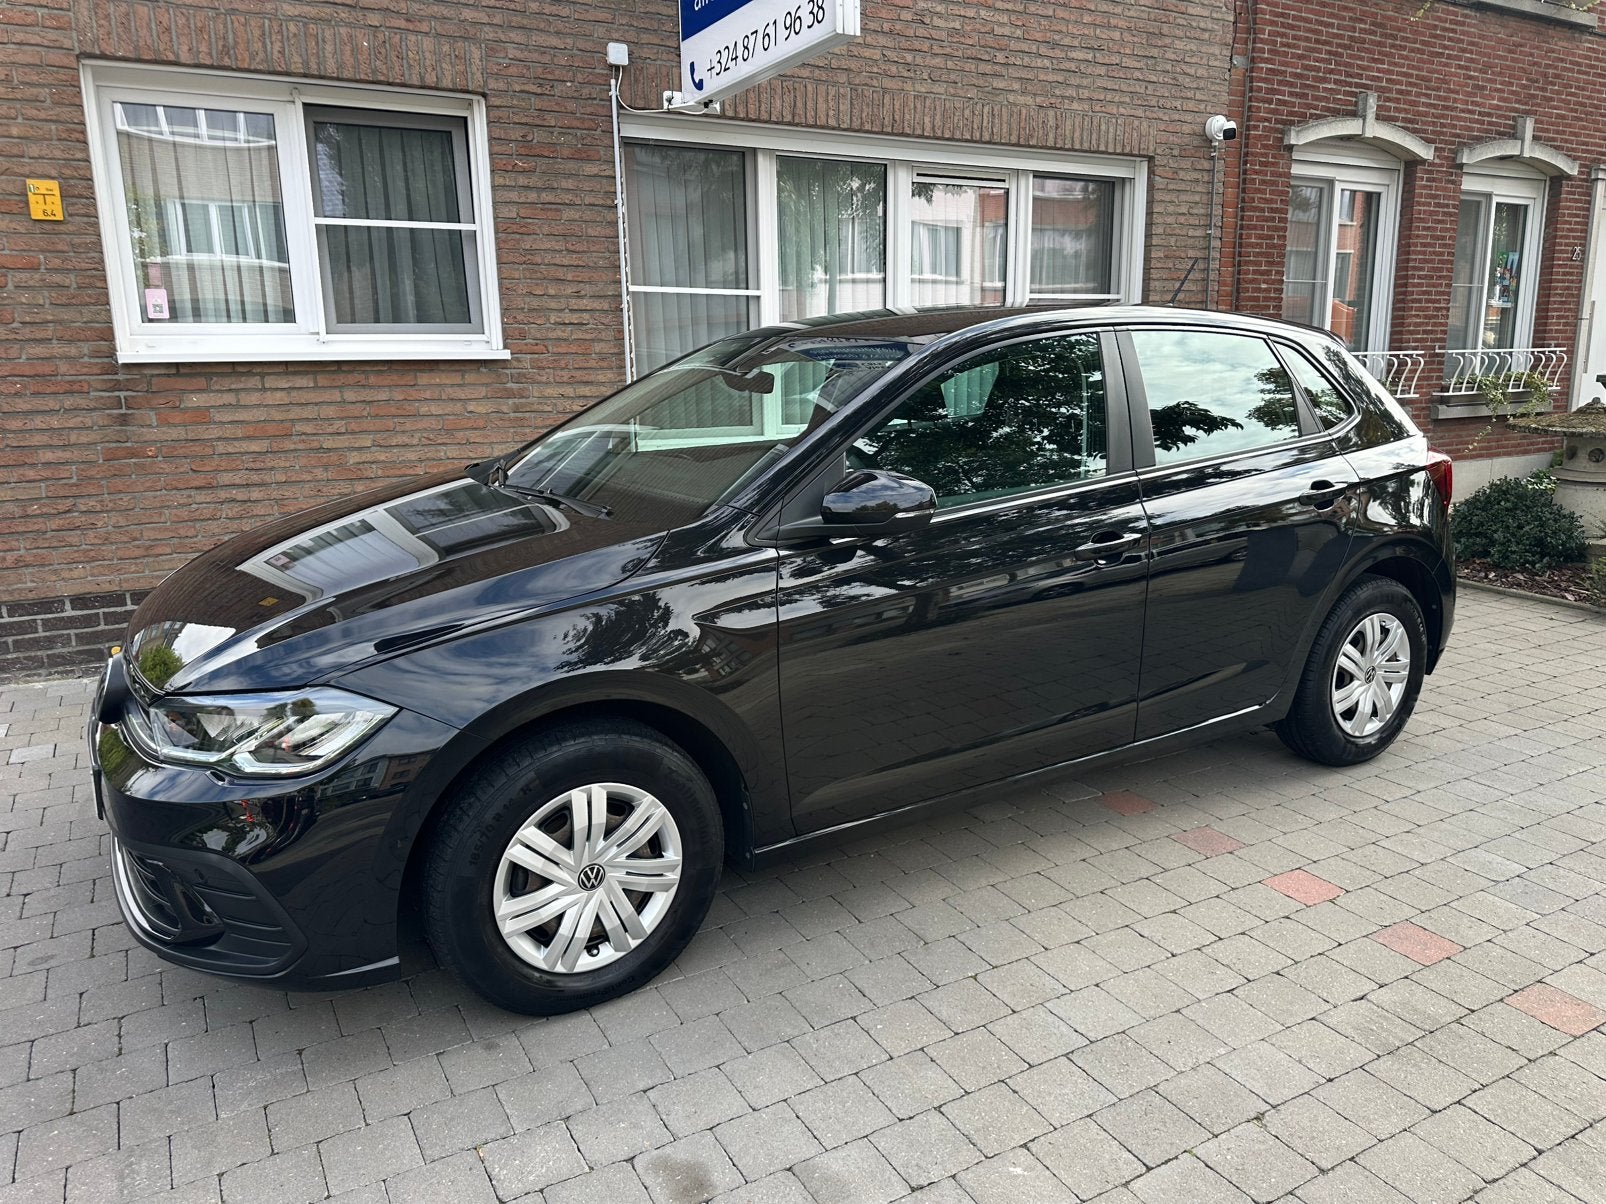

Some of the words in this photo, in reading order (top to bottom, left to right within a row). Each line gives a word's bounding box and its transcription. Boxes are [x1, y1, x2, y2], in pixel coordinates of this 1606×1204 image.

[706, 40, 739, 79] +324
[741, 29, 759, 62] 87
[761, 18, 777, 52] 61
[783, 5, 803, 42] 96
[806, 0, 826, 29] 38
